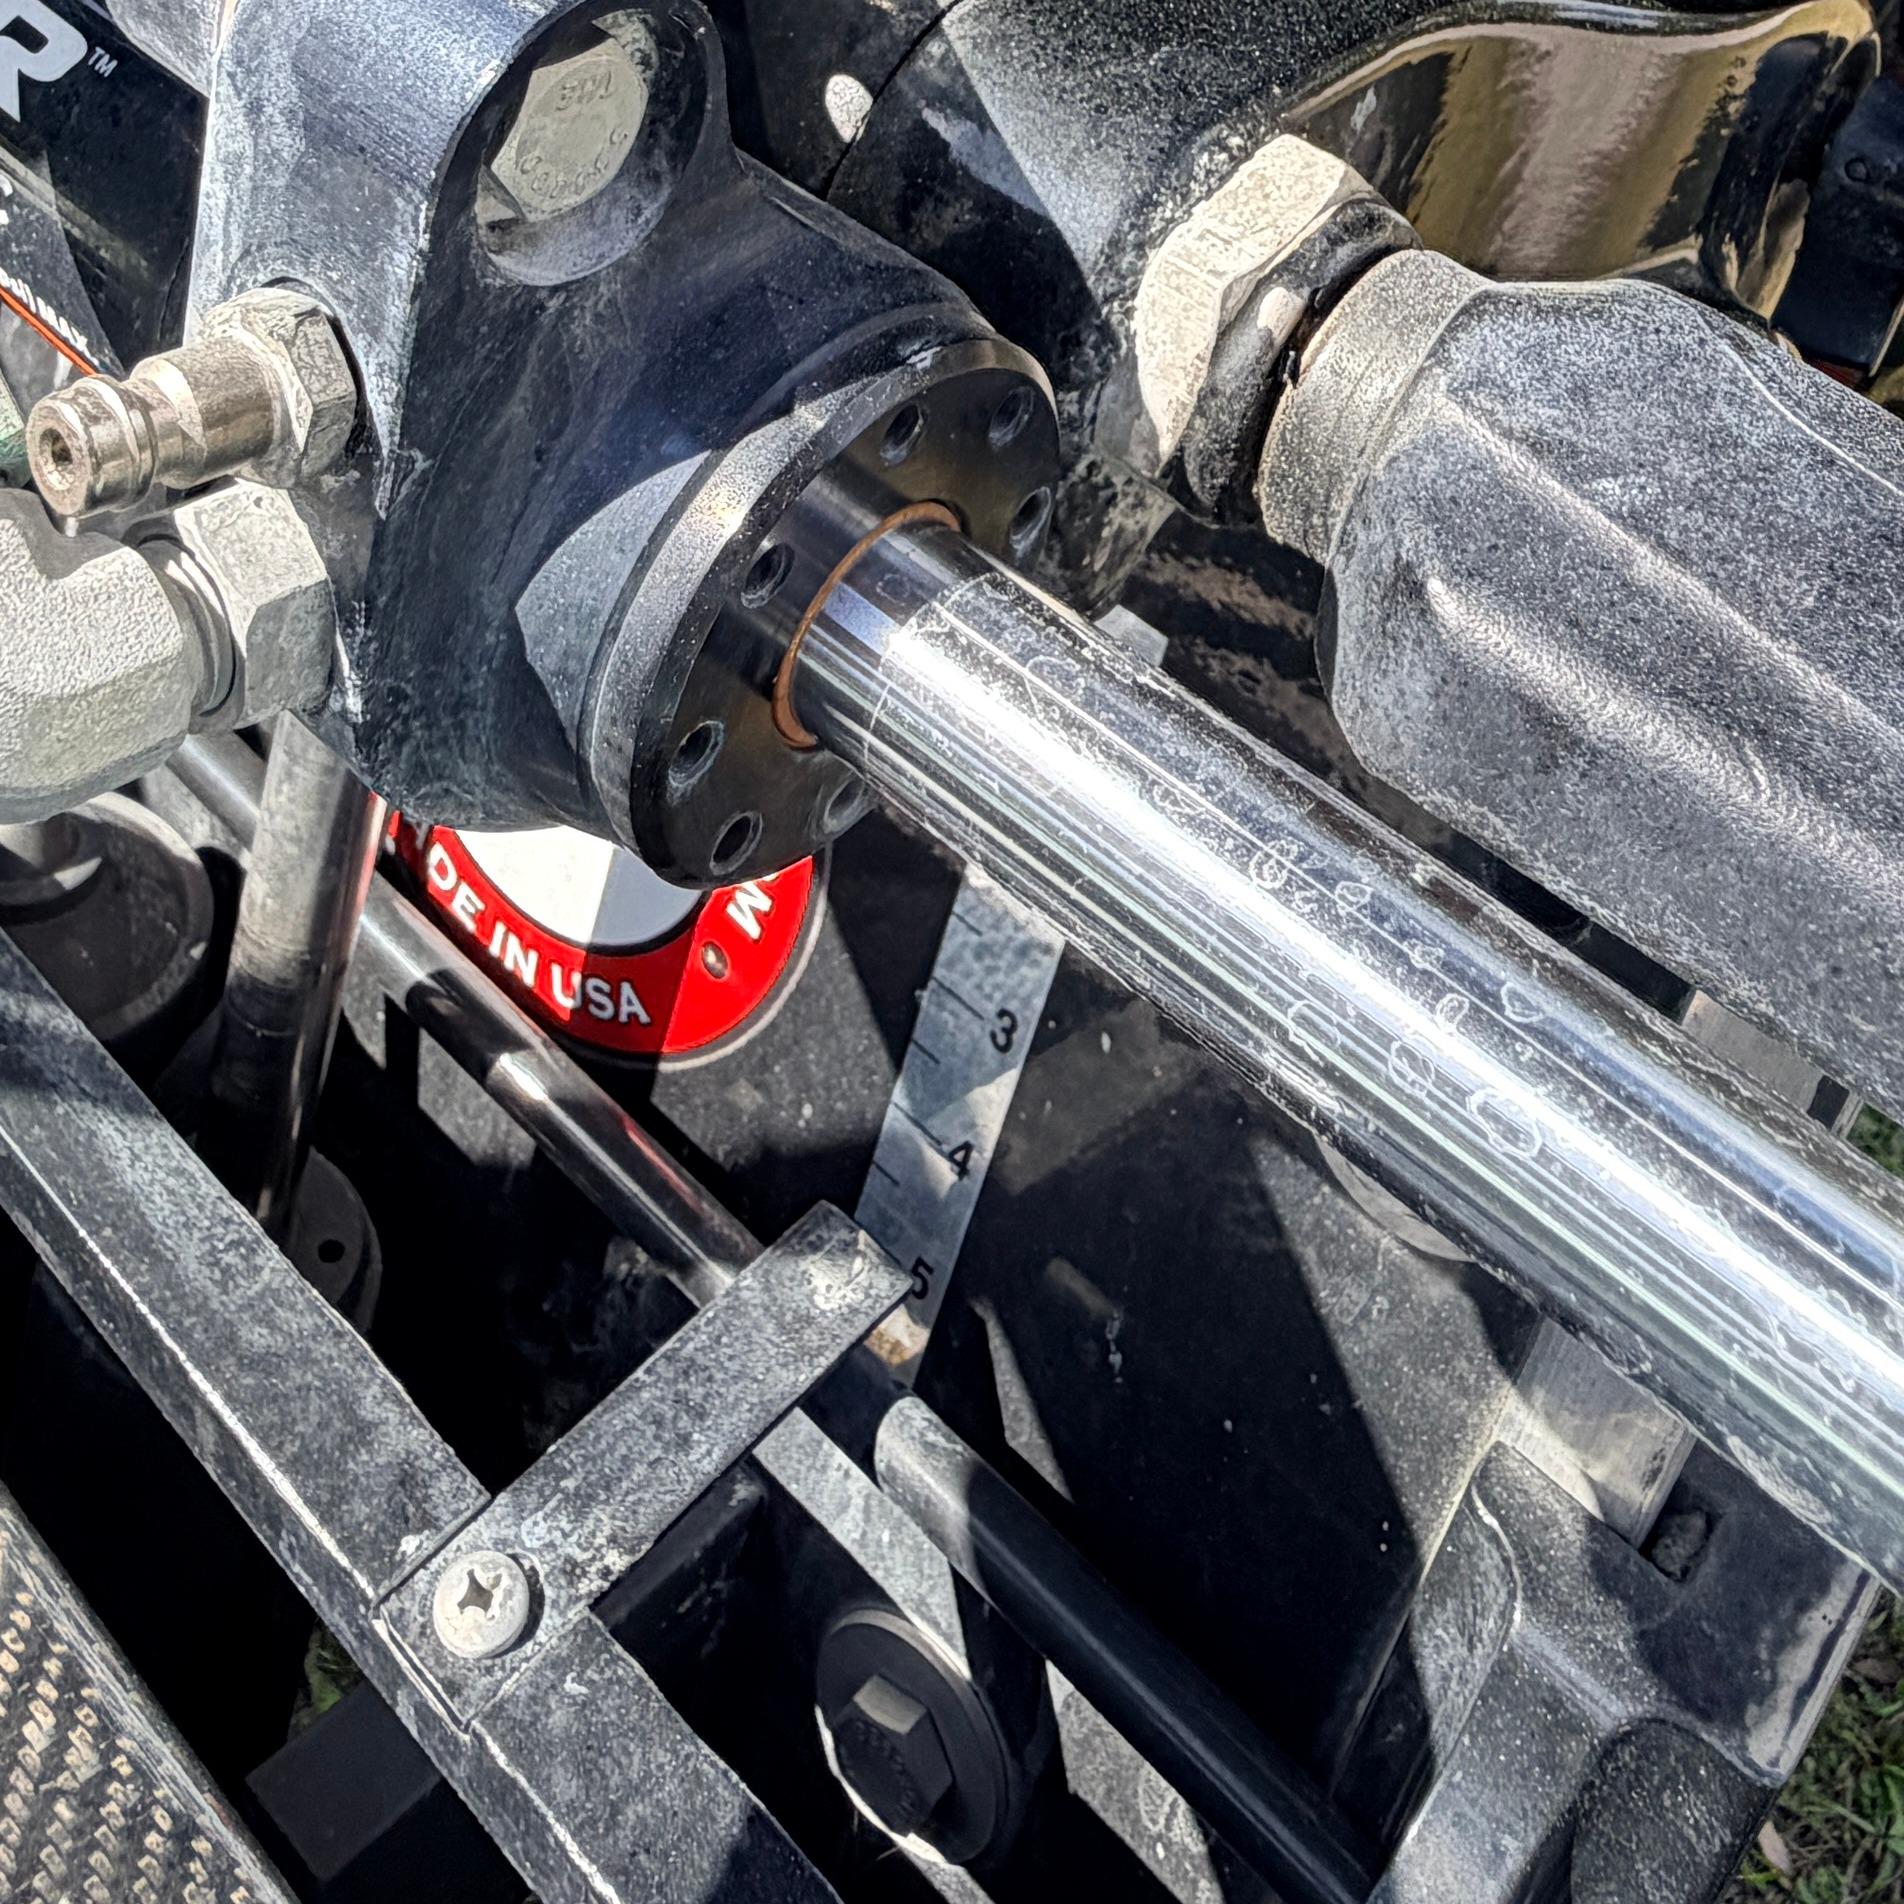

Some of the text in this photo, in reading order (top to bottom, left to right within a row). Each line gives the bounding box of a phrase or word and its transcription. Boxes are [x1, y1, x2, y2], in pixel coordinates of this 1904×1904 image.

[488, 920, 540, 987] IN
[549, 960, 653, 1026] USA
[990, 1008, 1018, 1054] 3
[948, 1140, 975, 1182] 4
[910, 1256, 934, 1300] 5
